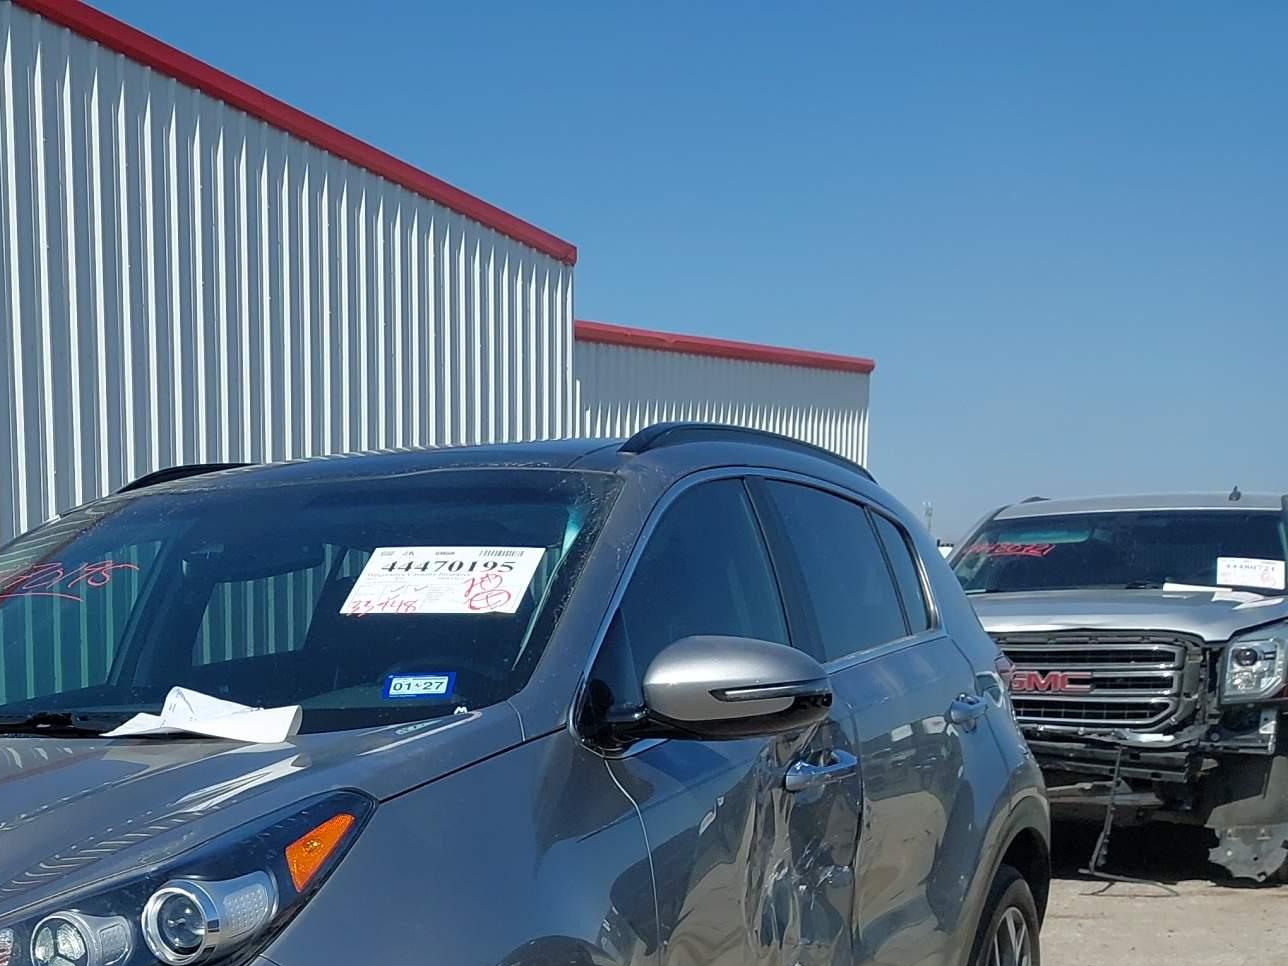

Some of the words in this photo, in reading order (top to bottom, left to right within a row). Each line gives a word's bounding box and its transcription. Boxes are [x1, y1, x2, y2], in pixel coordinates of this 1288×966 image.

[380, 560, 517, 573] 44470195
[392, 682, 412, 691] 01
[423, 681, 444, 690] 27
[1012, 671, 1092, 693] GMC
